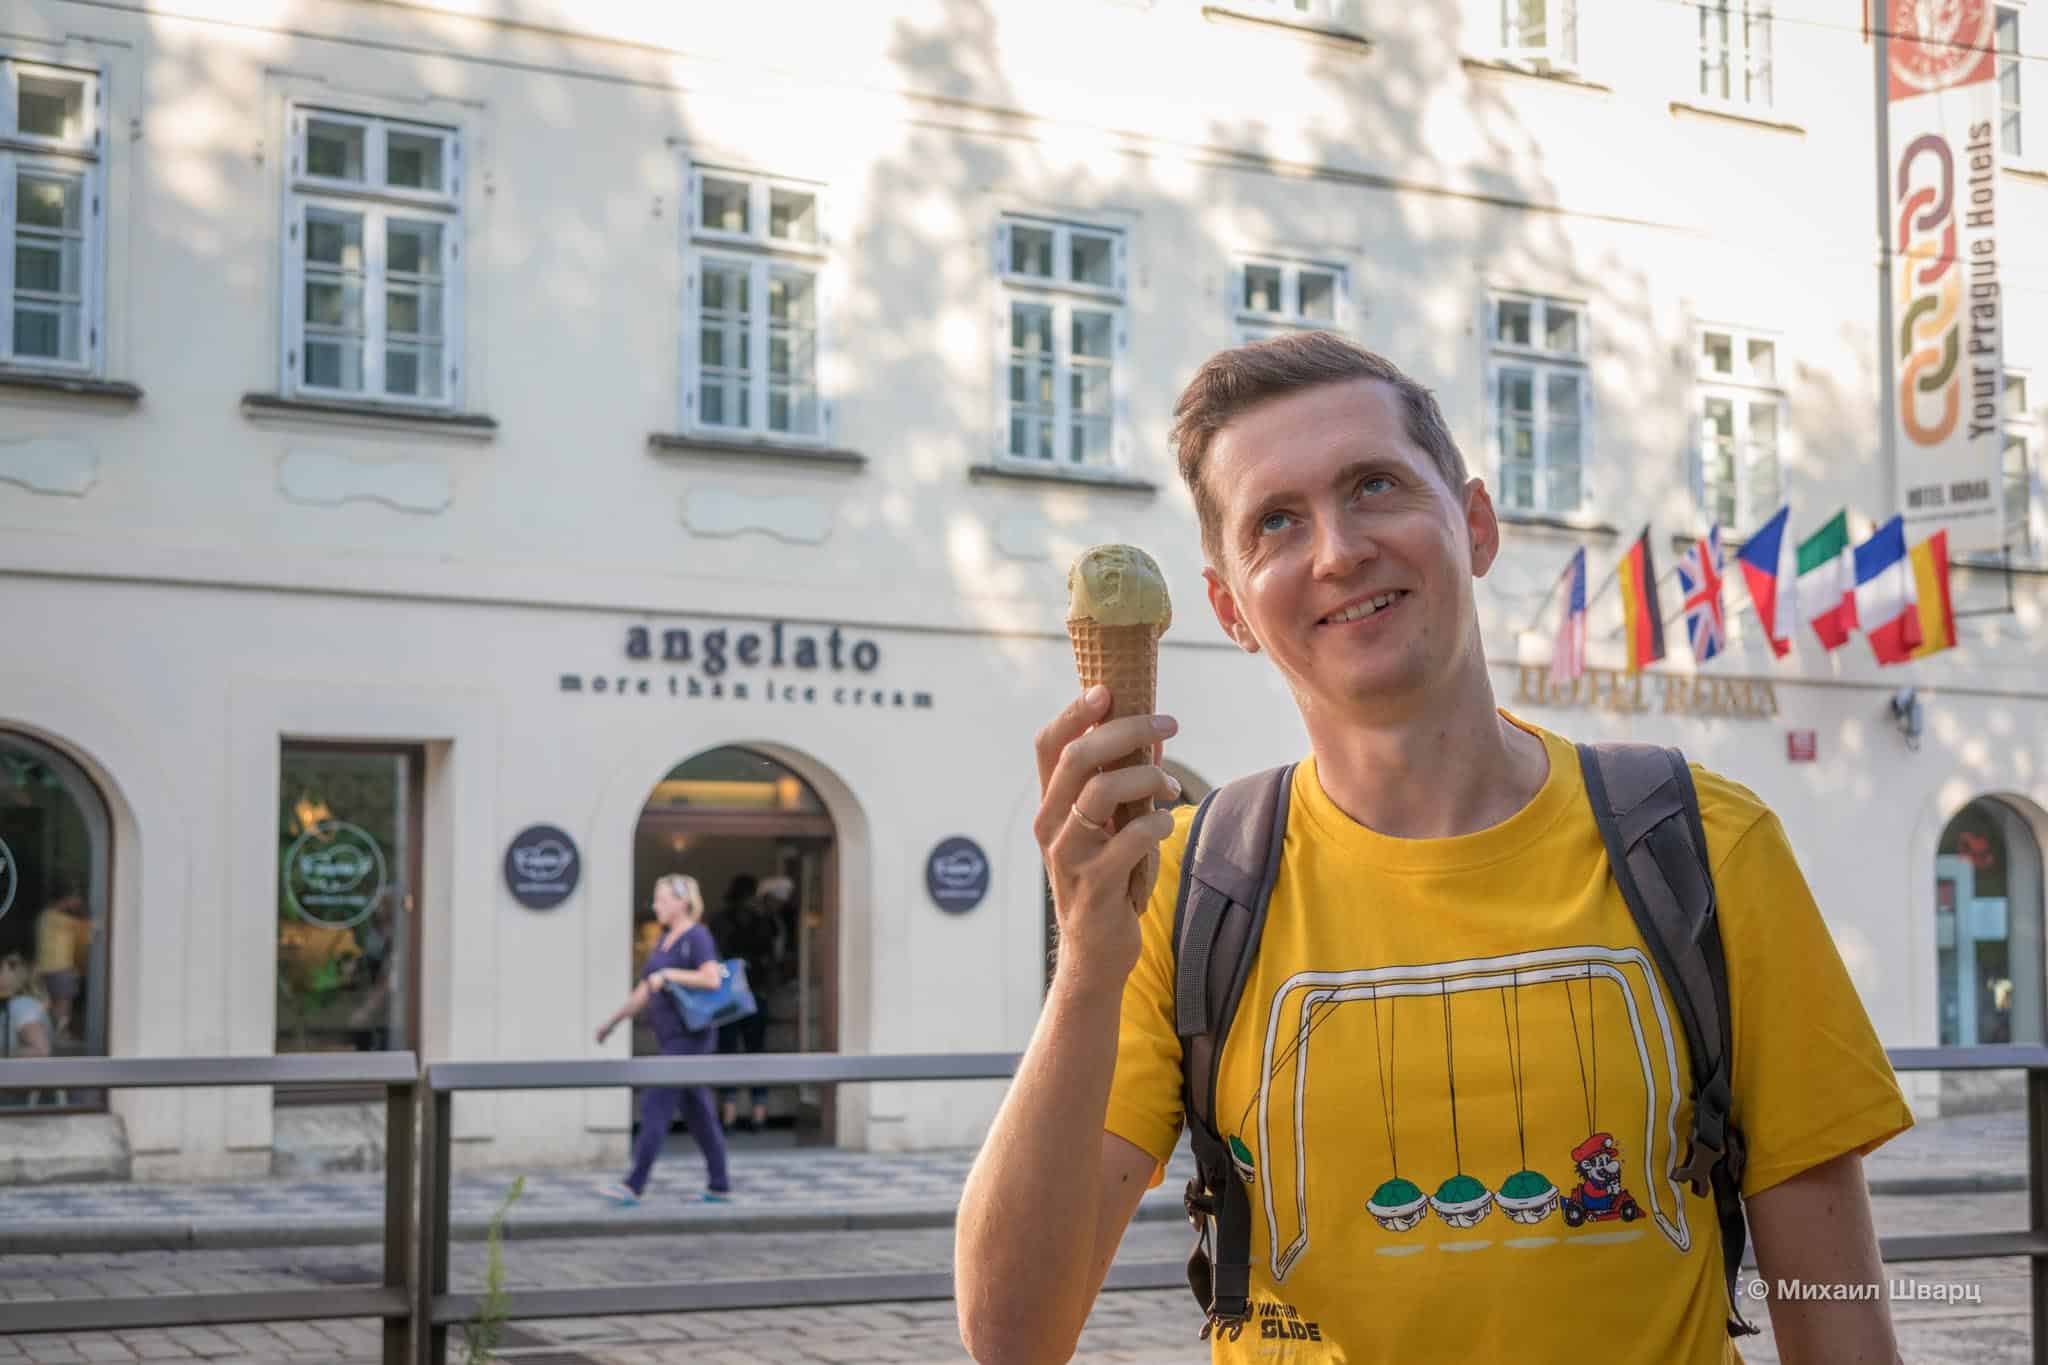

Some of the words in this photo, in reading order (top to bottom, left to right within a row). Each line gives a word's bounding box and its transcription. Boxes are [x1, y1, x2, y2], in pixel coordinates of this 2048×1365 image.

[1966, 119, 1996, 230] Hotels
[1968, 236, 2000, 358] Prague
[1968, 365, 1997, 441] Your
[624, 620, 880, 675] angelato
[559, 673, 650, 695] more
[668, 675, 751, 700] than
[765, 680, 818, 703] ice
[833, 686, 934, 708] cream
